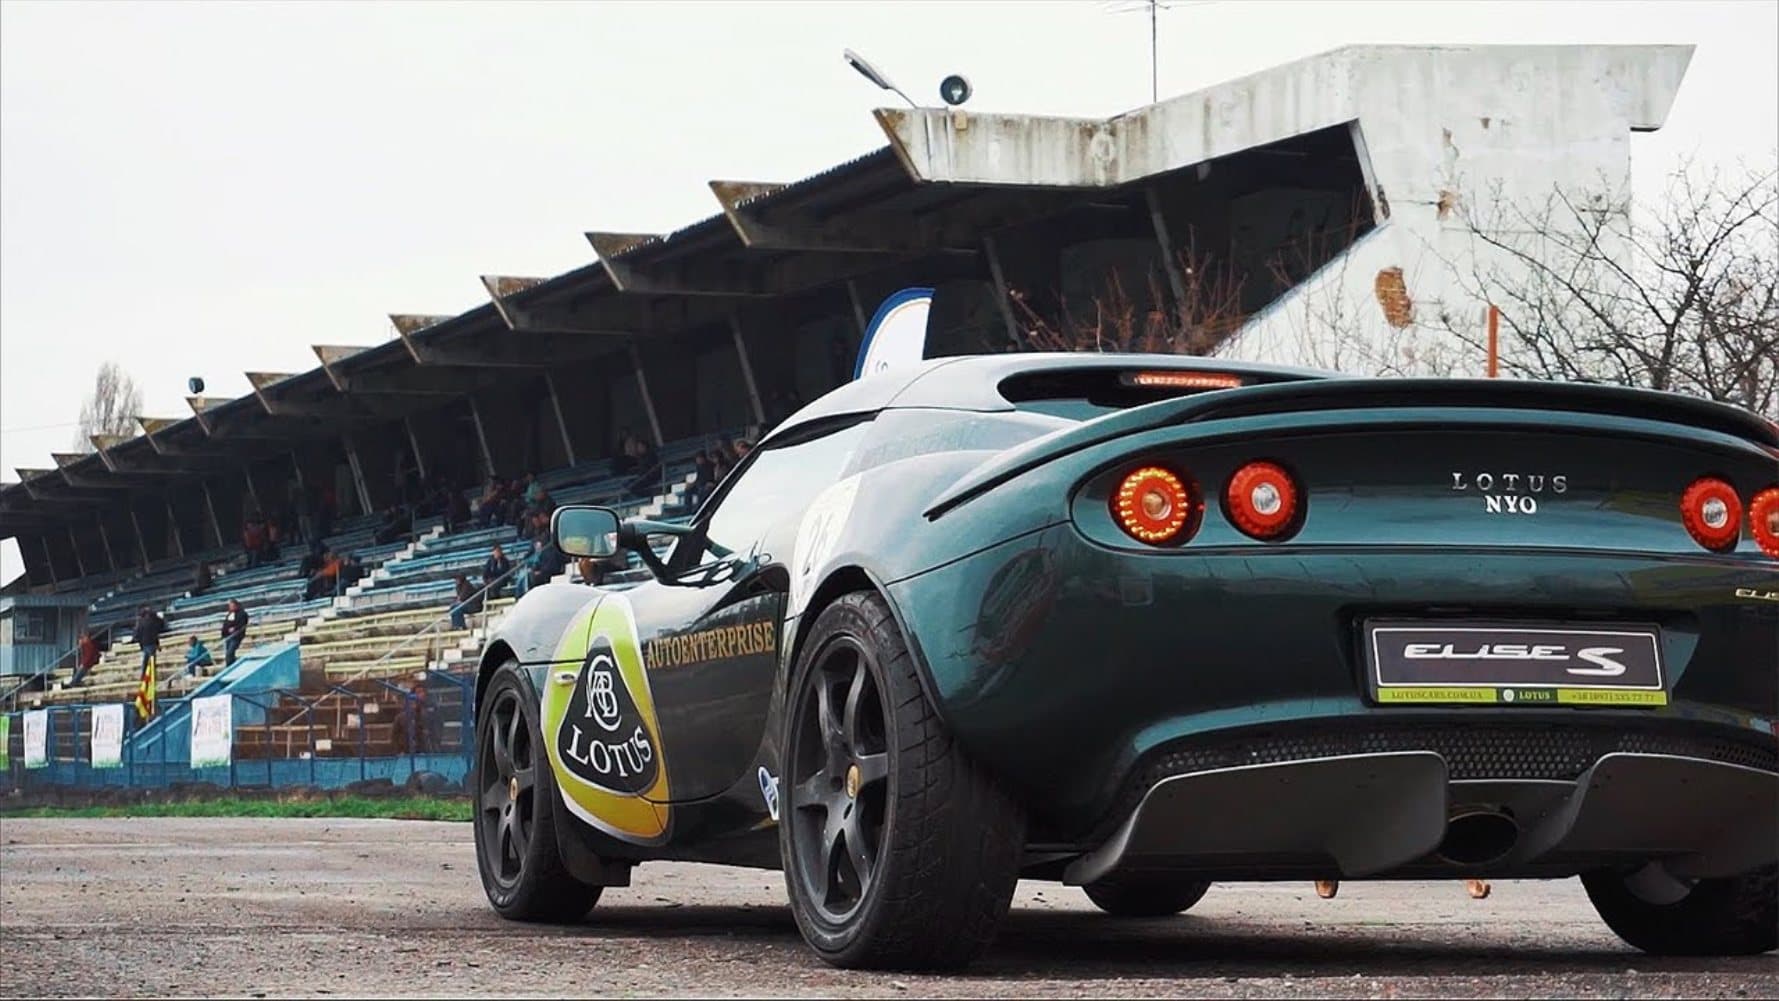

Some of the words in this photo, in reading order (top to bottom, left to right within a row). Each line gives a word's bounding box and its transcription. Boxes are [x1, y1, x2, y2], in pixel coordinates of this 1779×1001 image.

[1452, 472, 1567, 493] LOTUS
[1485, 495, 1537, 514] NYO
[645, 621, 776, 670] AUTOENTERPRISE
[1404, 644, 1570, 660] ELISE
[1566, 647, 1626, 676] S
[1519, 690, 1550, 700] LOTUS
[566, 725, 652, 777] LOTUS
